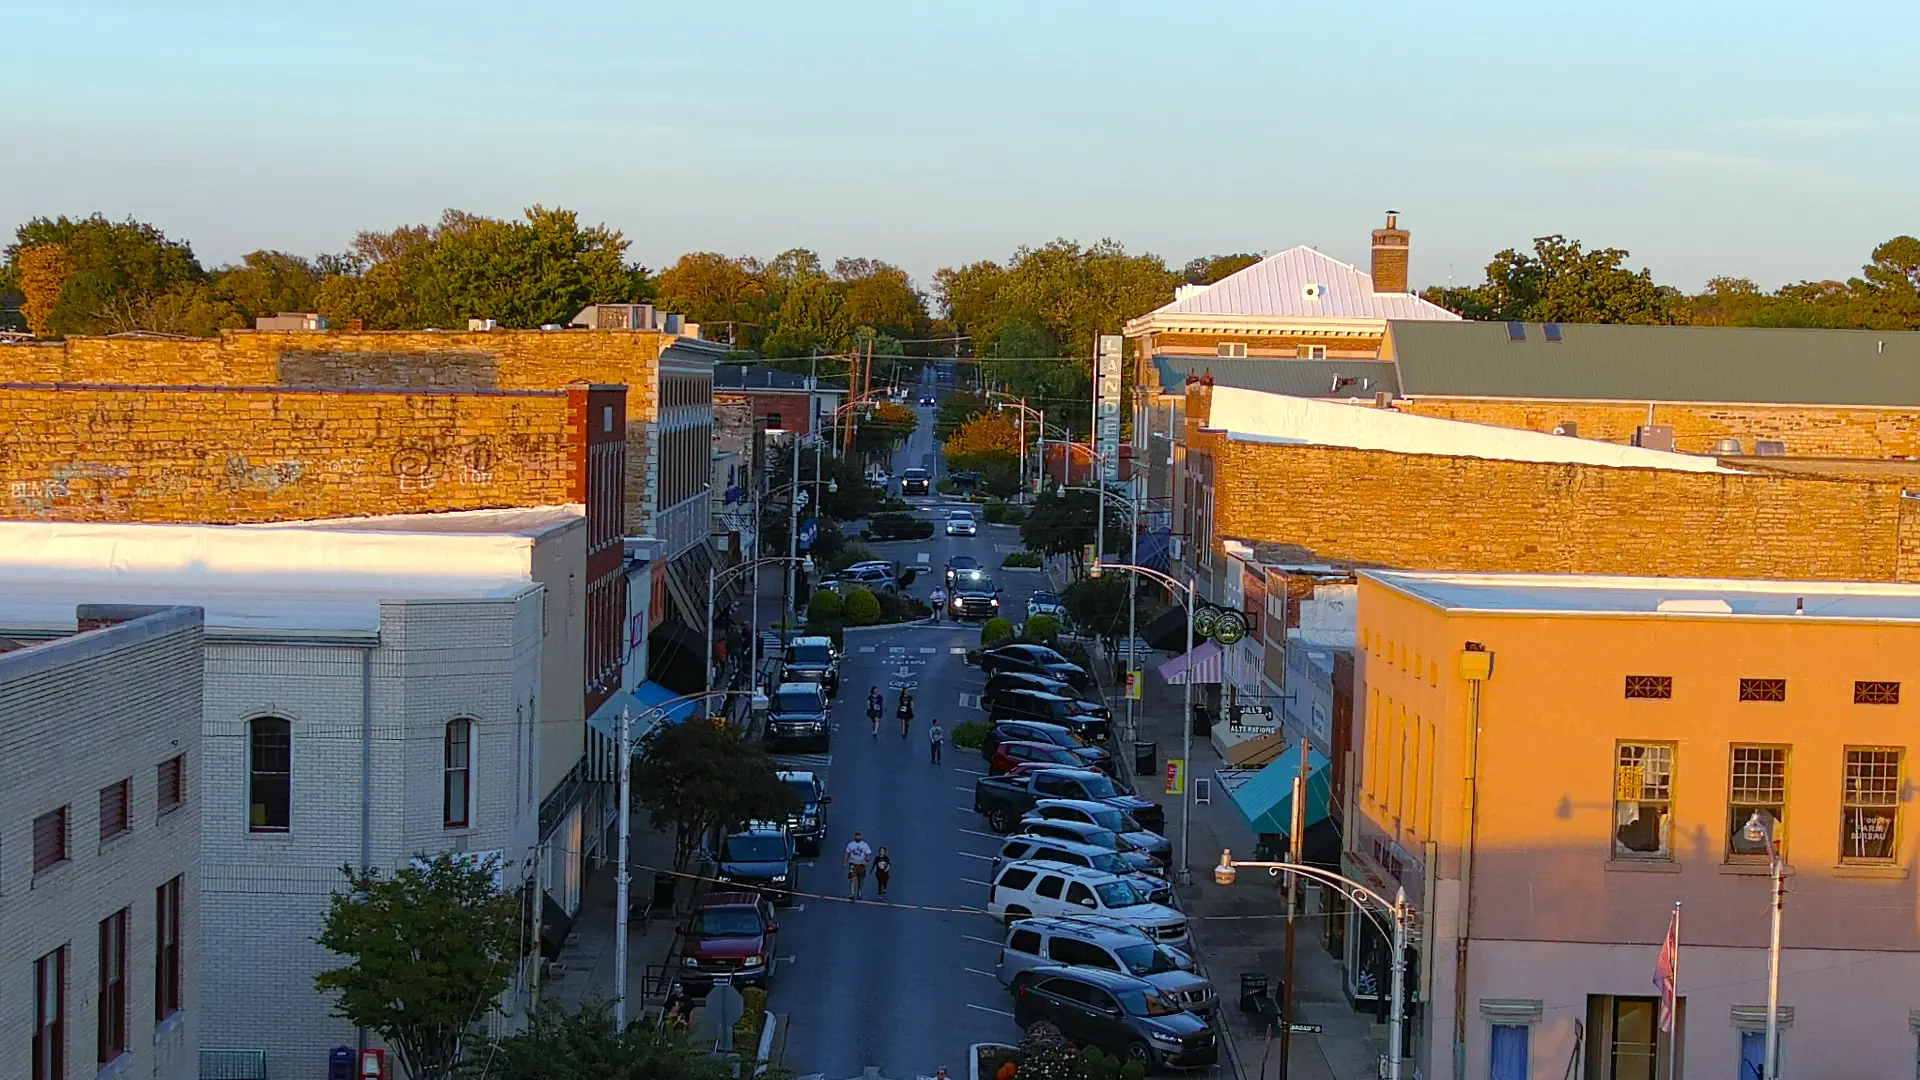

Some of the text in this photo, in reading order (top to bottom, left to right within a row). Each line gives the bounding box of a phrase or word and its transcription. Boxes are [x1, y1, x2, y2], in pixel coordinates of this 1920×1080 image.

[1103, 339, 1119, 477] LANDERS
[1240, 706, 1263, 714] JILL'S
[1230, 725, 1276, 734] ALTERATIONS
